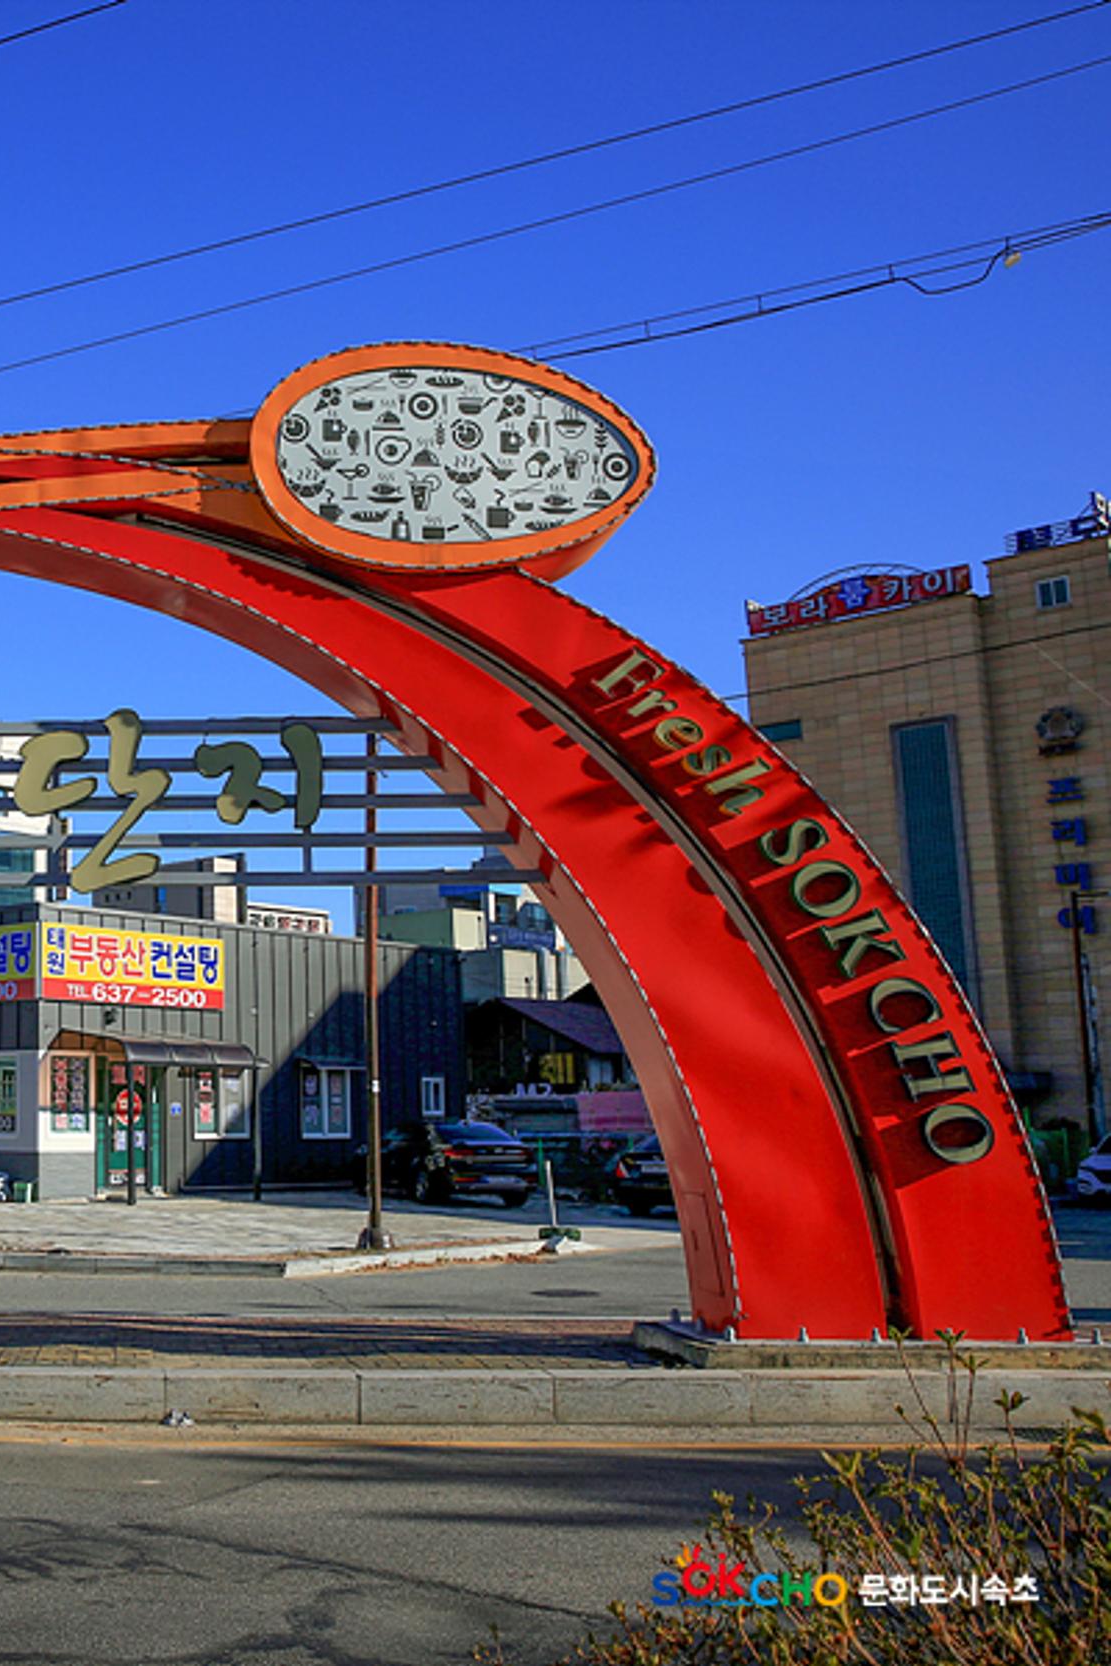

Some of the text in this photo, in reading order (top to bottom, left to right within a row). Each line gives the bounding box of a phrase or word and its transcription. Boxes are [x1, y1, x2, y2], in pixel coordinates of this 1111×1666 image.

[589, 646, 775, 819] Fresh
[70, 934, 219, 984] 부동산 컨설팅
[91, 982, 206, 1008] 637-2500
[758, 817, 995, 1165] SOKCHO
